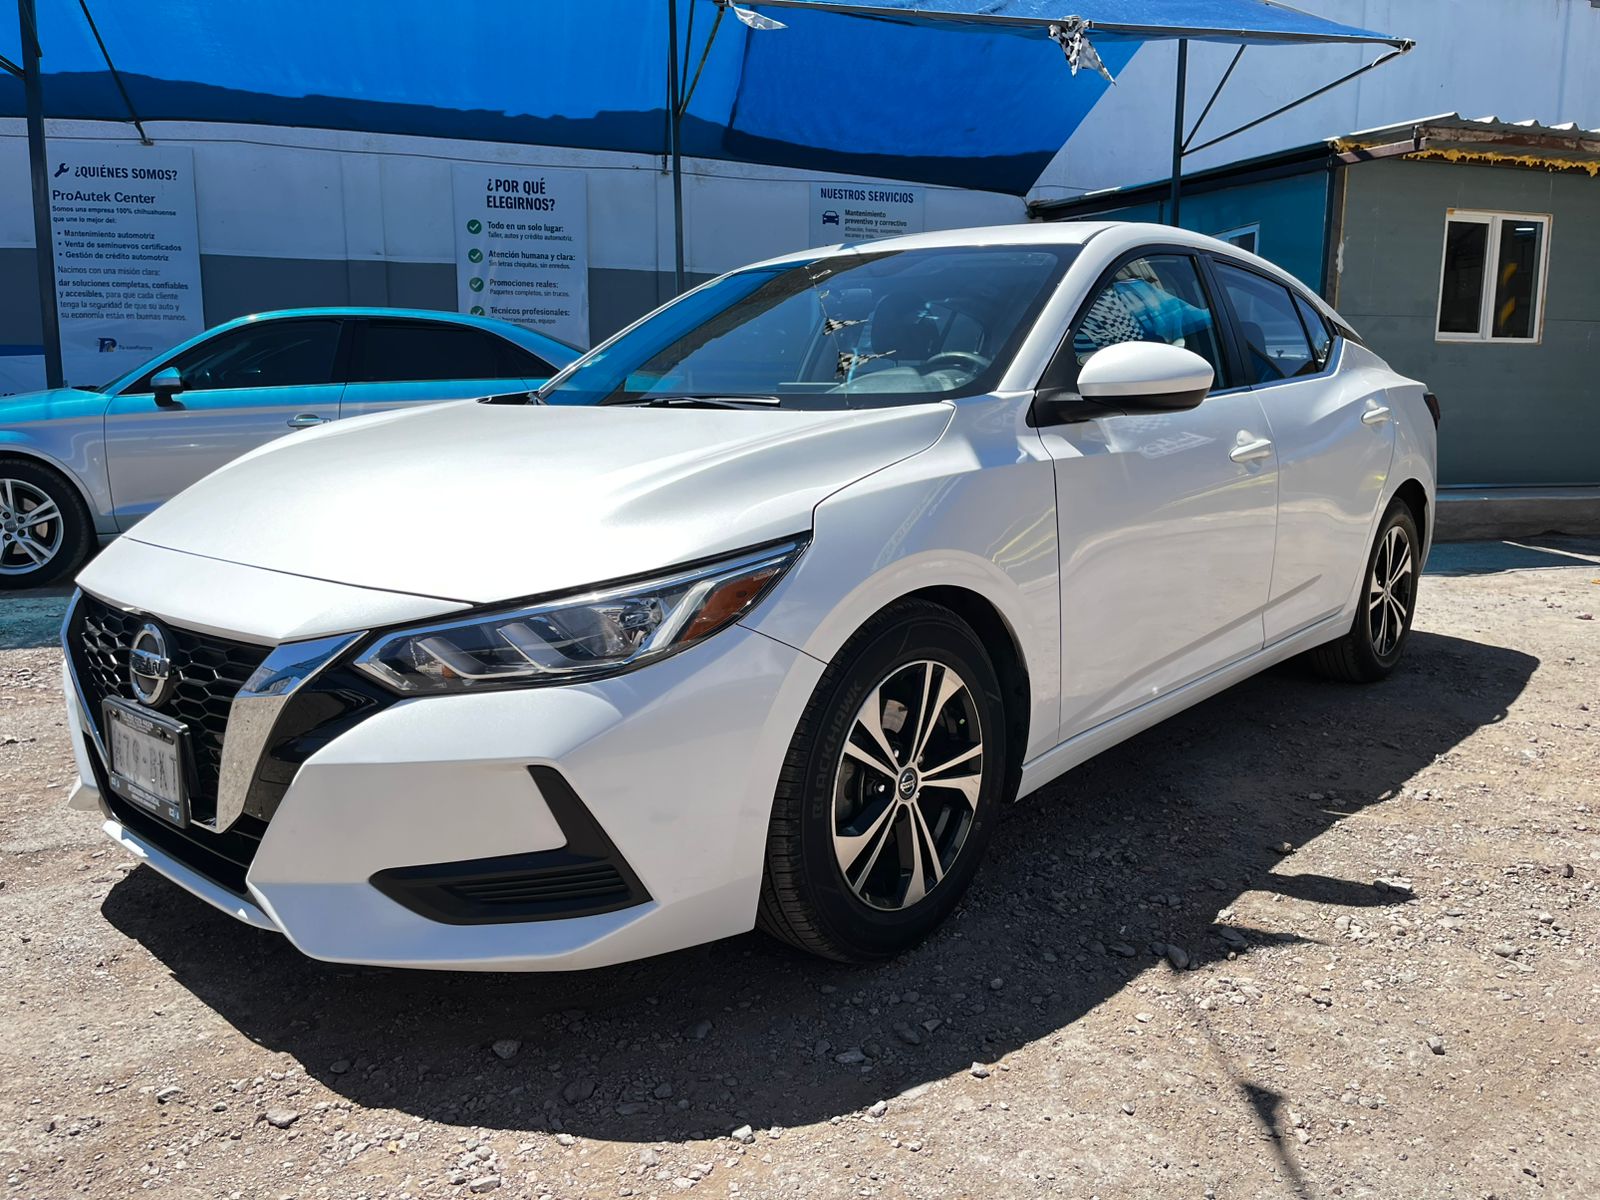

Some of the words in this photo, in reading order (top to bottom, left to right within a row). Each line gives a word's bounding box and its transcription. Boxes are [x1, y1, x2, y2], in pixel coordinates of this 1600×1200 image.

[74, 164, 128, 178] ¿QUIÉNES
[132, 168, 178, 180] SOMOS?
[523, 178, 546, 195] QUÉ
[52, 190, 111, 202] ProAutek
[114, 192, 156, 204] Center
[820, 188, 865, 200] NUESTROS
[868, 191, 914, 203] SERVICIOS
[487, 195, 555, 211] ELEGIRNOS?
[845, 209, 886, 218] Mantenimiento
[488, 221, 504, 229] Todo
[544, 224, 564, 234] lugar:
[64, 230, 116, 238] Mantenimiento
[117, 231, 155, 239] automotriz
[140, 243, 182, 251] certificados
[65, 251, 93, 259] Gestión
[489, 250, 519, 258] Atención
[521, 251, 549, 260] humana
[118, 267, 140, 276] misión
[111, 281, 151, 289] completas,
[152, 281, 188, 290] confiables
[490, 279, 534, 287] Promociones
[65, 290, 104, 299] accesibles,
[137, 291, 154, 299] cada
[522, 307, 570, 316] profesionales:
